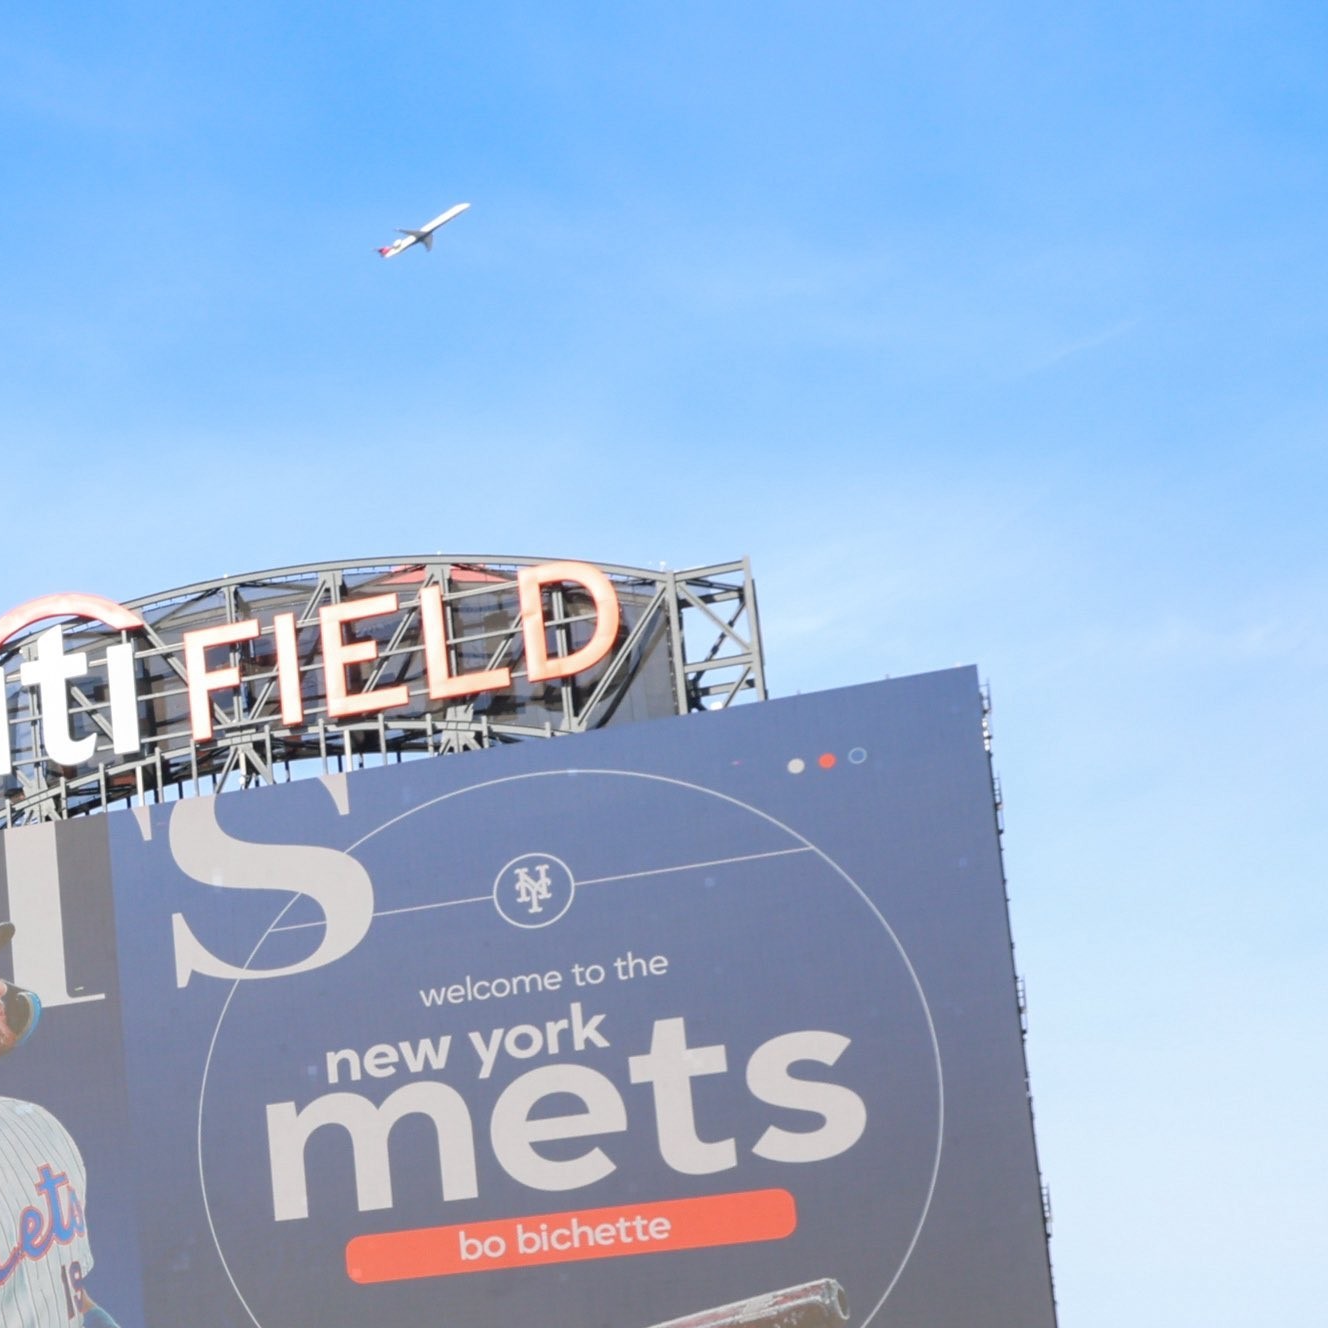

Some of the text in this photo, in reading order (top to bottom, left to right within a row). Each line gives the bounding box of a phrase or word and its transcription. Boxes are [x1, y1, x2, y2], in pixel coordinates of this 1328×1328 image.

[182, 559, 622, 743] FIELD
[419, 951, 669, 1007] welcome to the
[325, 1001, 611, 1085] new york
[265, 1016, 868, 1223] mets
[458, 1212, 672, 1262] bo bichette
